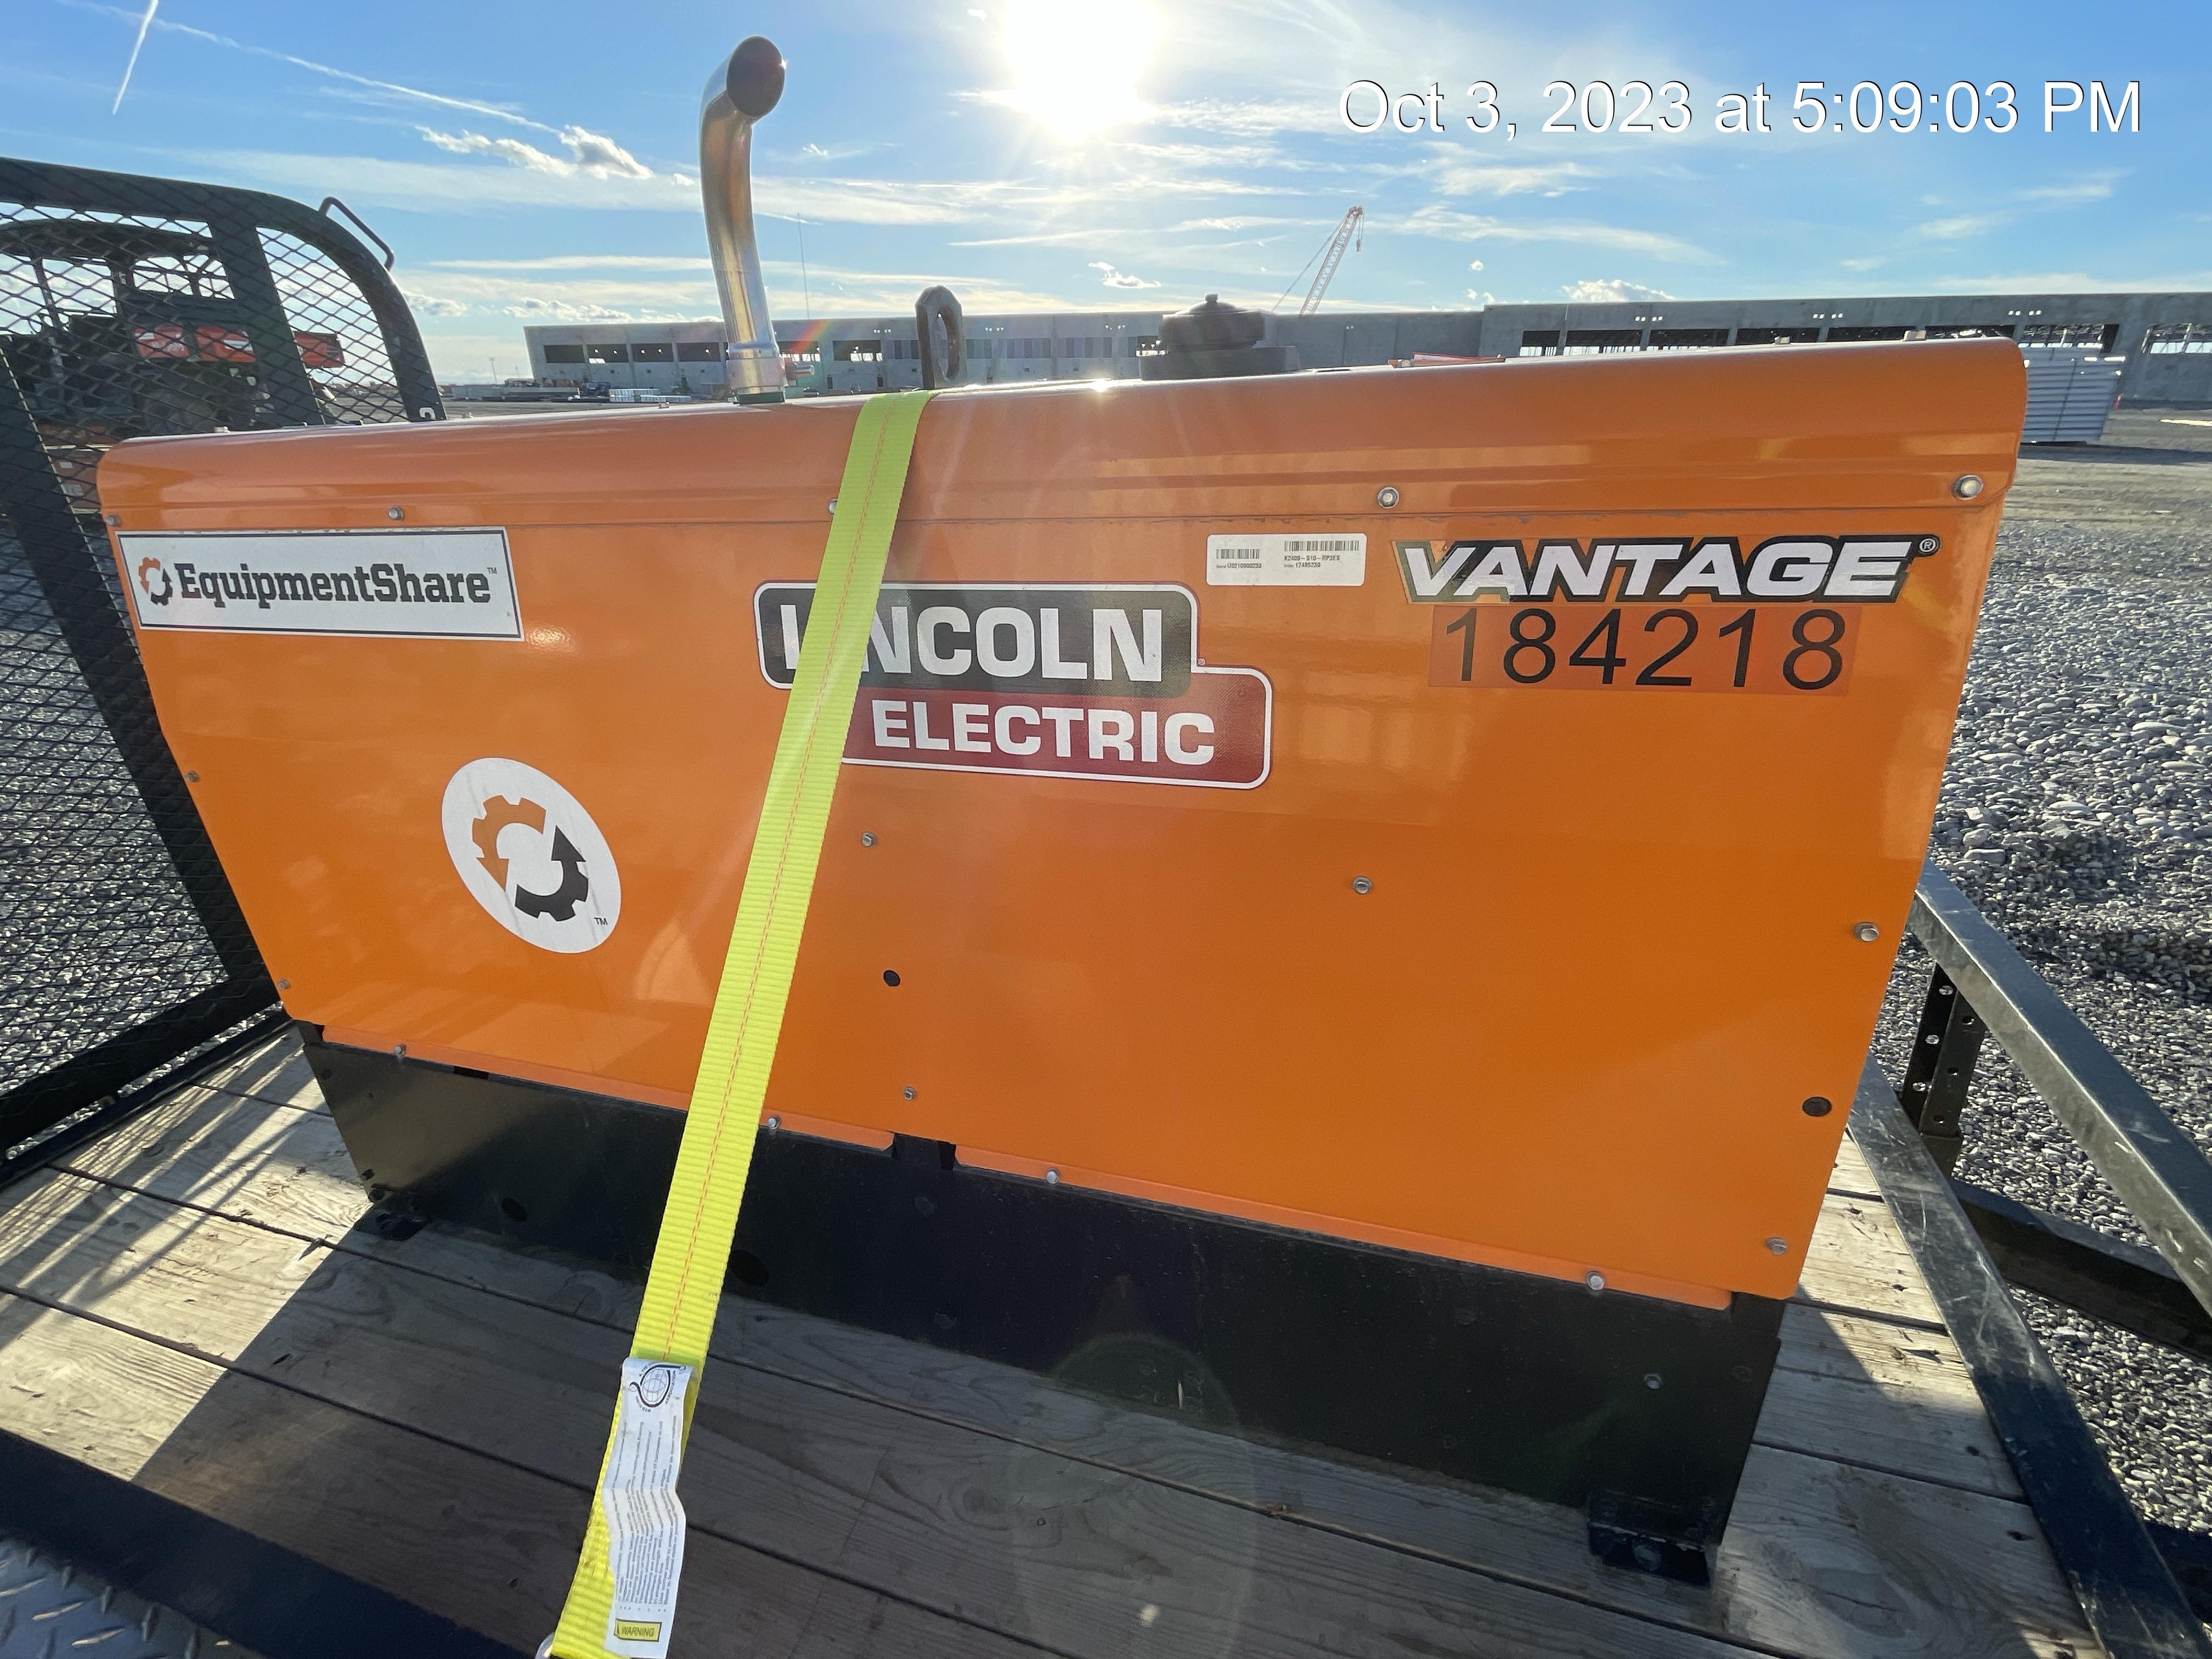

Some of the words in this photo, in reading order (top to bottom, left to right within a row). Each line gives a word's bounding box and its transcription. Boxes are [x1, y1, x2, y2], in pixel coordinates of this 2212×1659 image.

[174, 563, 491, 608] EquipmentShare
[1404, 540, 1911, 596] VANTAGE
[780, 605, 1162, 682] LNCOLN
[1446, 608, 1845, 690] 184218
[872, 699, 1215, 766] ELECTRIC
[622, 1627, 654, 1637] WARNING
